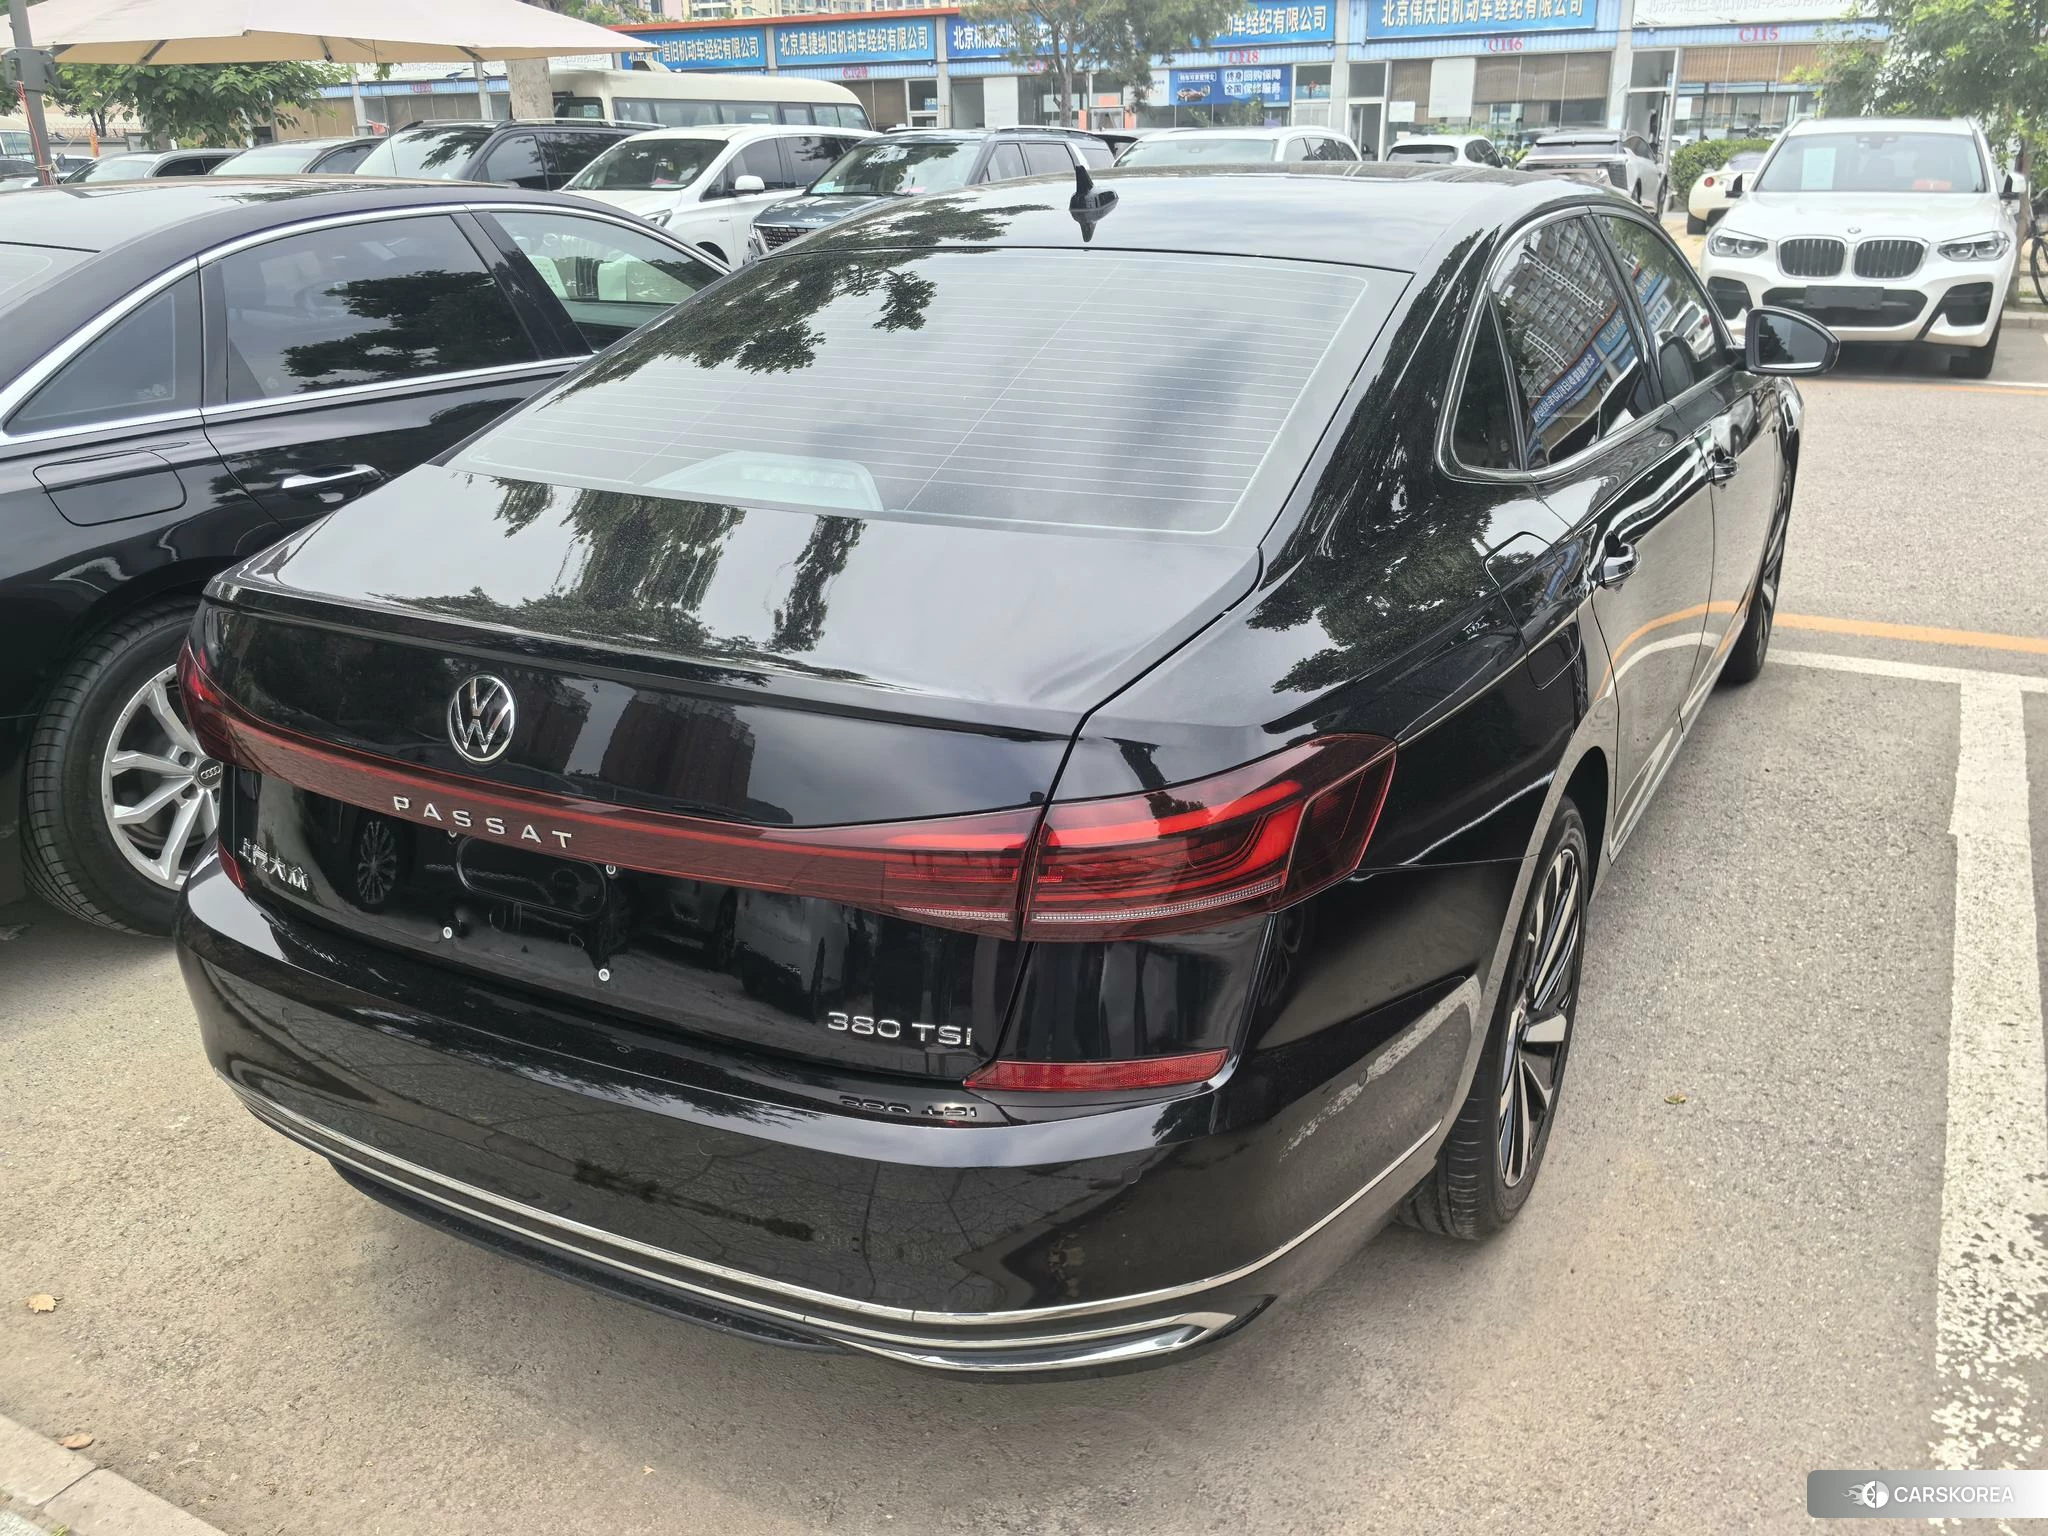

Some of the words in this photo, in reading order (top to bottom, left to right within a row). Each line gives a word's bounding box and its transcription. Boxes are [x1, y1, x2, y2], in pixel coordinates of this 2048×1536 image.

[1488, 37, 1523, 53] C116
[1739, 26, 1779, 43] C115
[1228, 49, 1260, 64] C118
[393, 796, 573, 848] PASSAT
[239, 837, 309, 892] 上汽大众
[827, 1011, 901, 1039] 380
[911, 1022, 973, 1046] TSI
